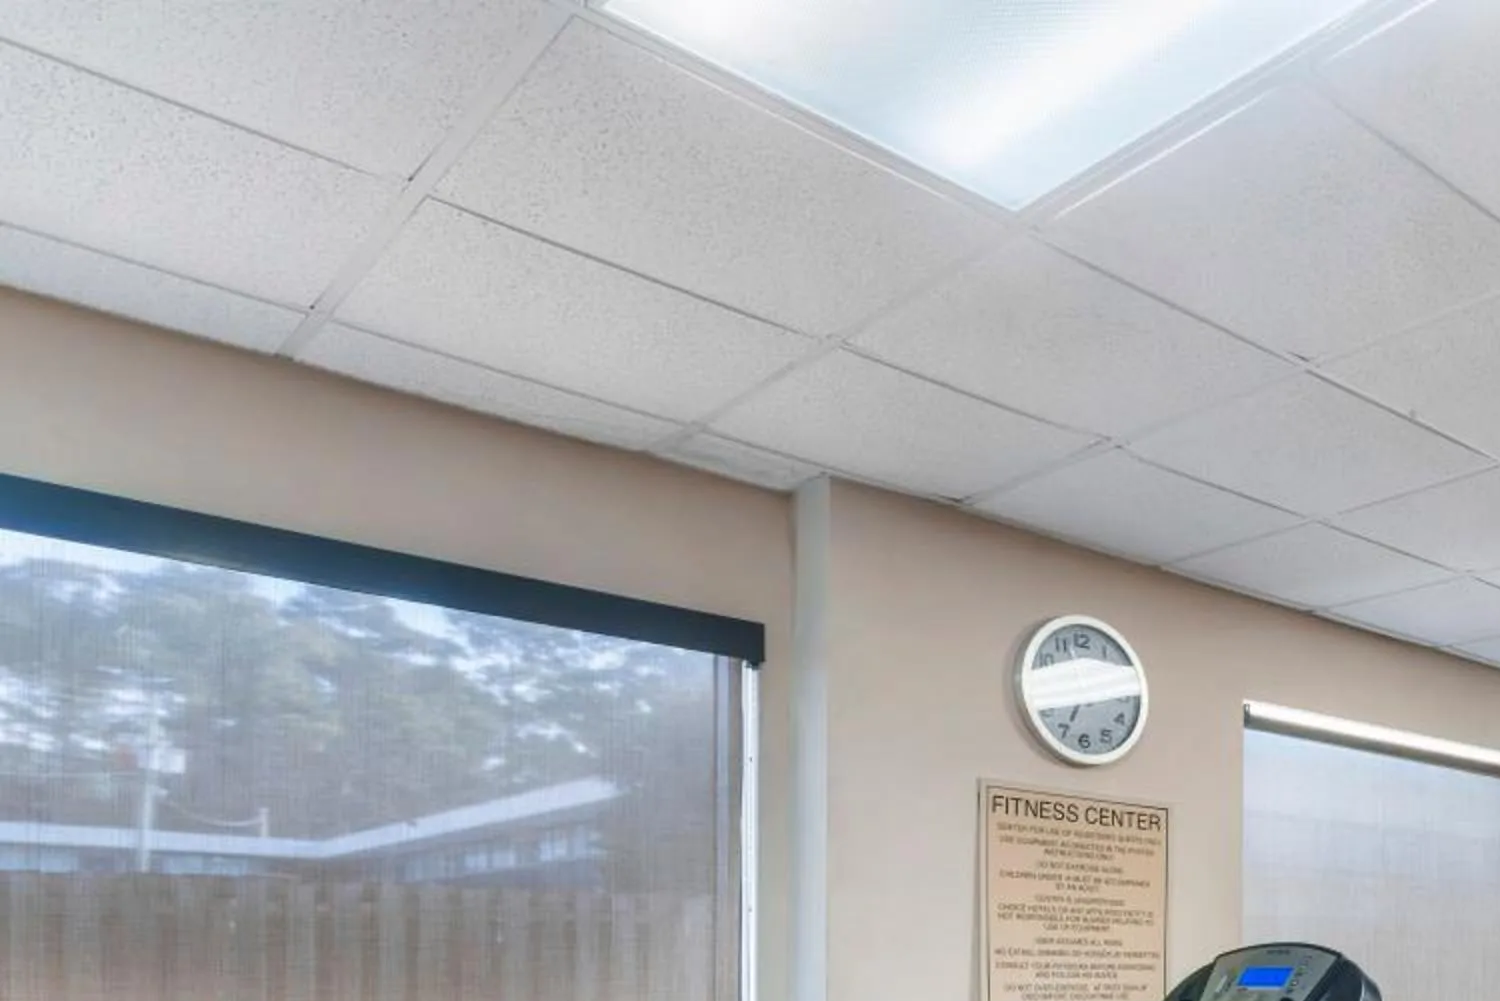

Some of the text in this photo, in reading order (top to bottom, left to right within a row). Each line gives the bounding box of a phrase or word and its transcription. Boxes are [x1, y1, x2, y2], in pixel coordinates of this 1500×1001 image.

[1055, 637, 1067, 652] 11
[1074, 633, 1090, 649] 12
[1113, 711, 1125, 725] 4
[1058, 723, 1070, 738] 7
[1100, 728, 1113, 744] 5
[1078, 733, 1091, 749] 6
[992, 794, 1161, 832] FITNESS CENTER
